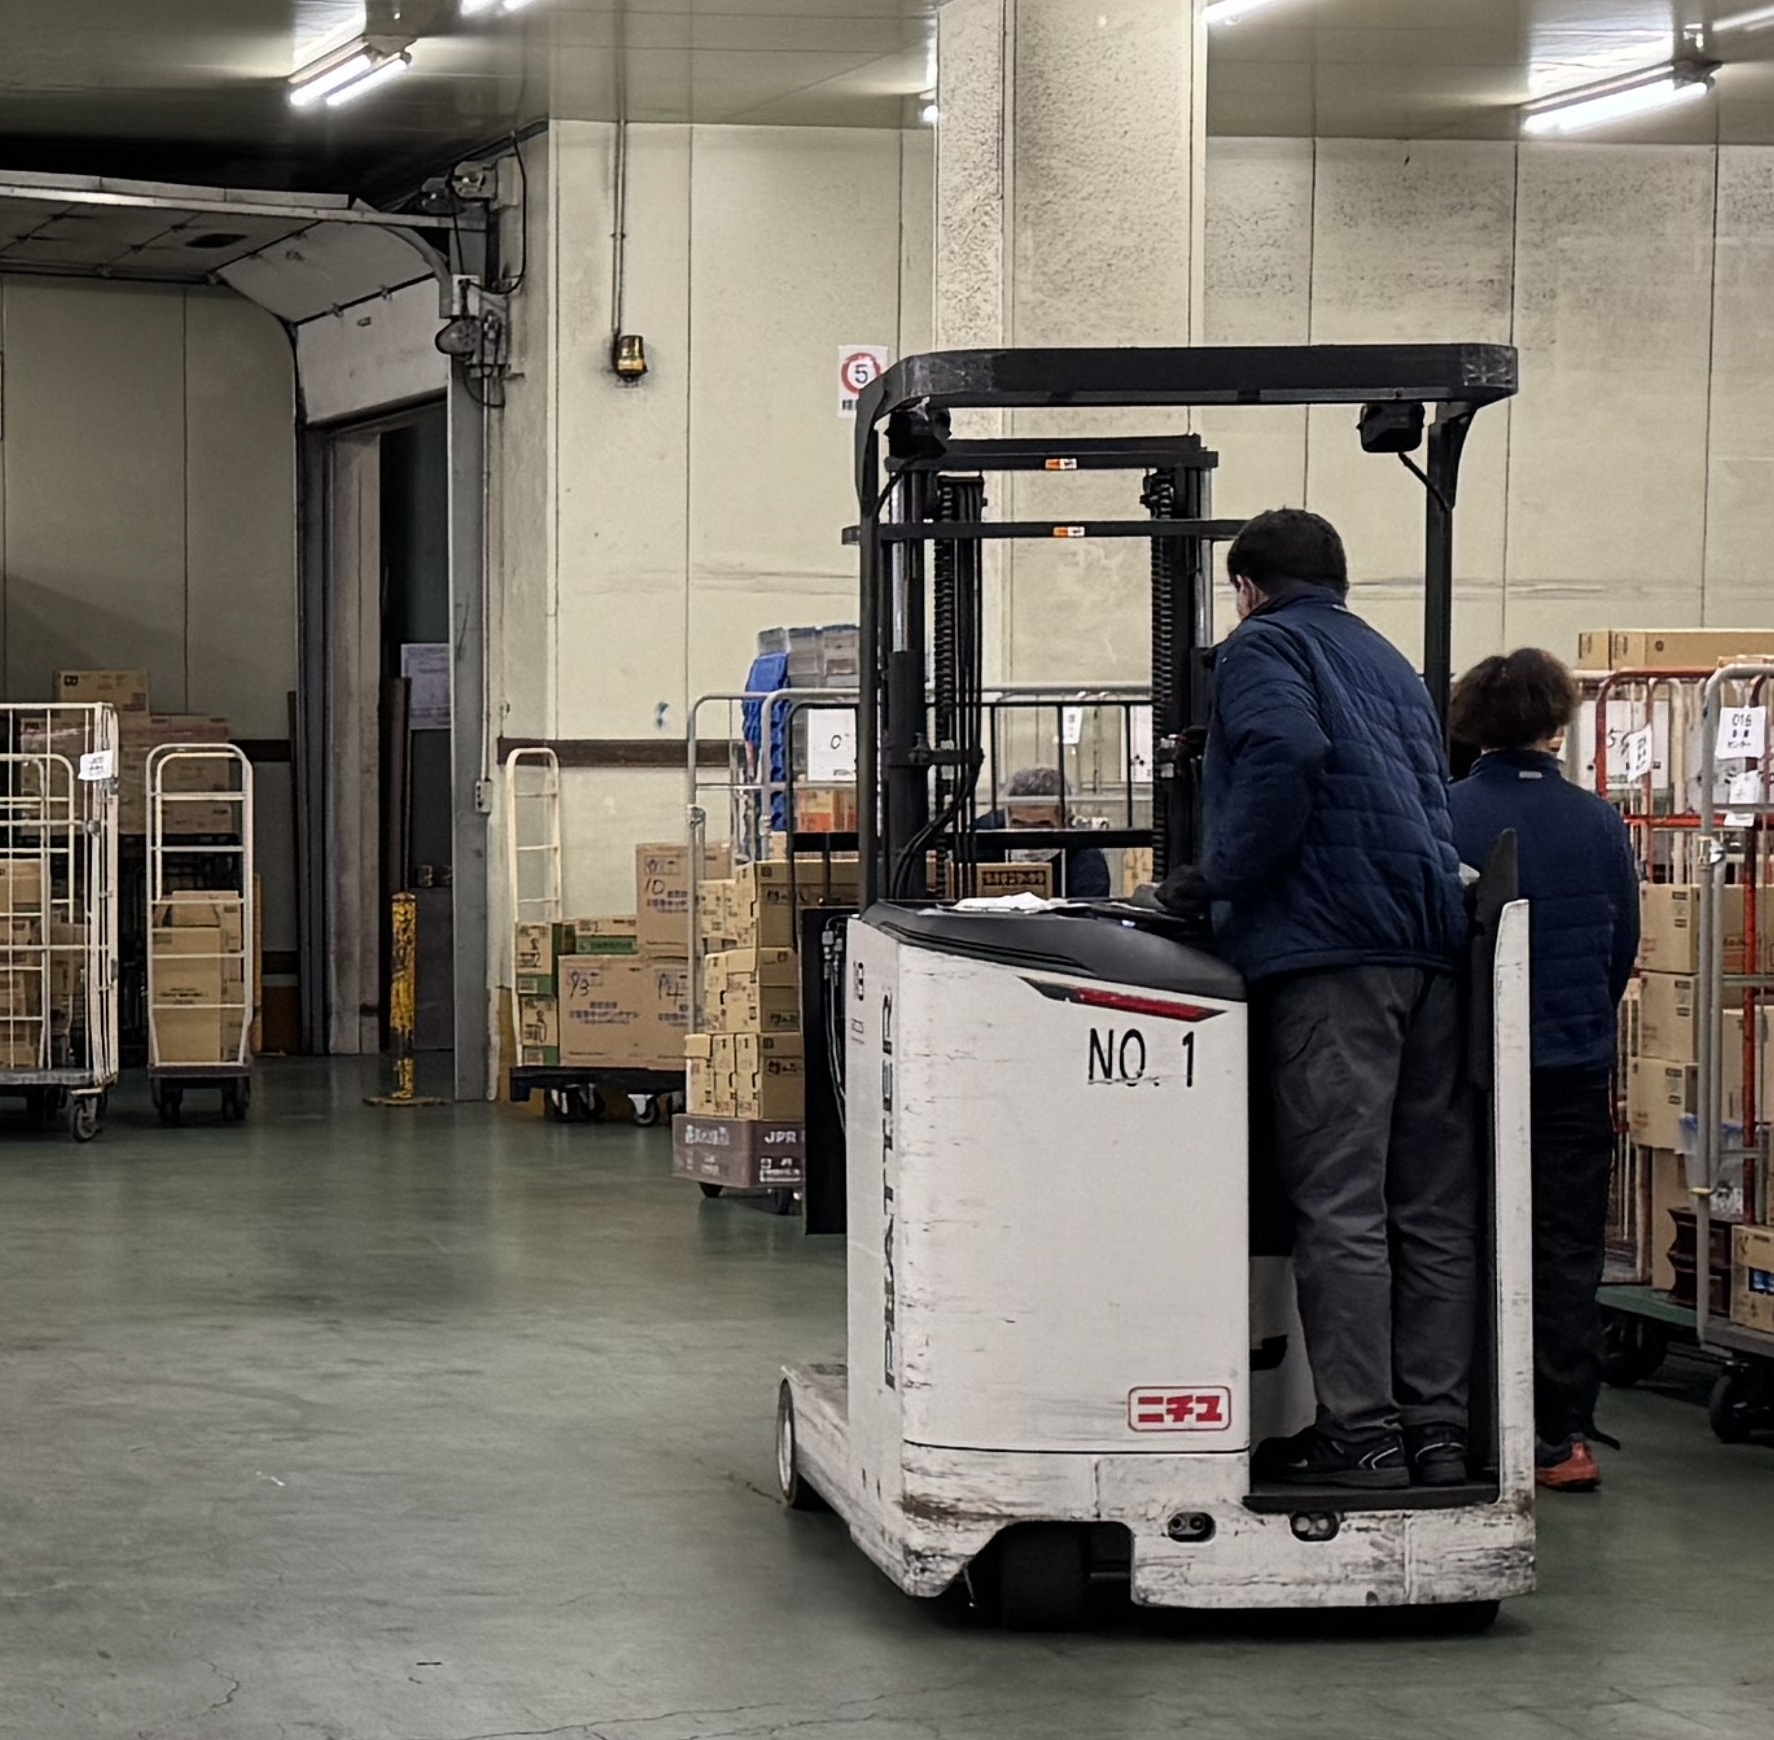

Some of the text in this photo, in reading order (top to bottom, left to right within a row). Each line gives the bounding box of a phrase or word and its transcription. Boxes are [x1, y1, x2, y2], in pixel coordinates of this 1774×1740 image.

[854, 363, 869, 384] 5
[1088, 1027, 1195, 1088] NO. 1
[764, 1130, 797, 1144] JPR
[1137, 1394, 1223, 1423] ニチユ
